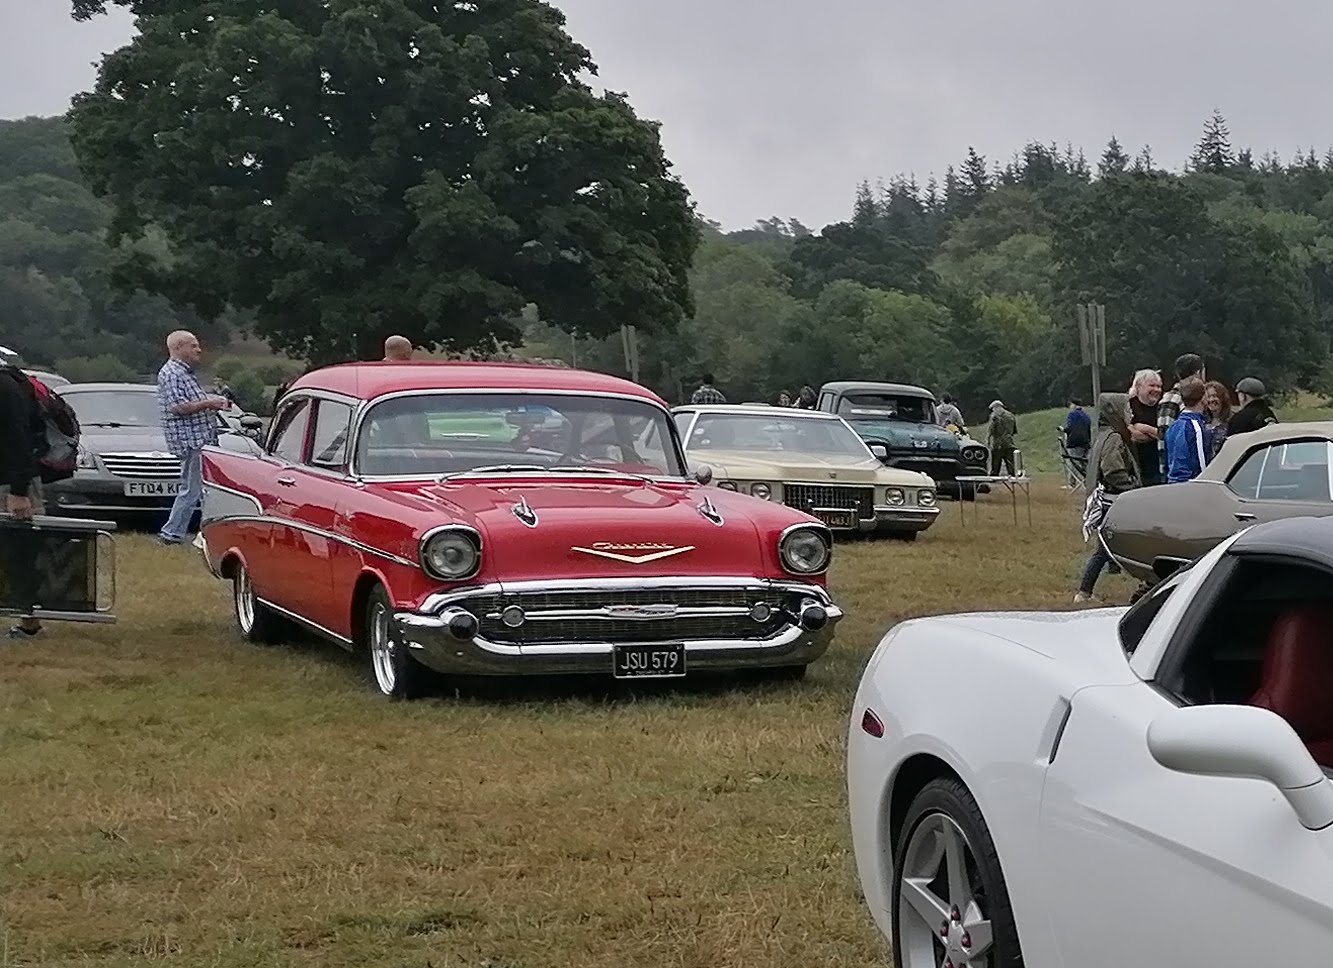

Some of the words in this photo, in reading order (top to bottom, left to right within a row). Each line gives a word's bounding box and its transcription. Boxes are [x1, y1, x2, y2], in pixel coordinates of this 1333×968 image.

[129, 482, 164, 494] FT04
[621, 651, 648, 670] JSU
[651, 651, 679, 669] 579
